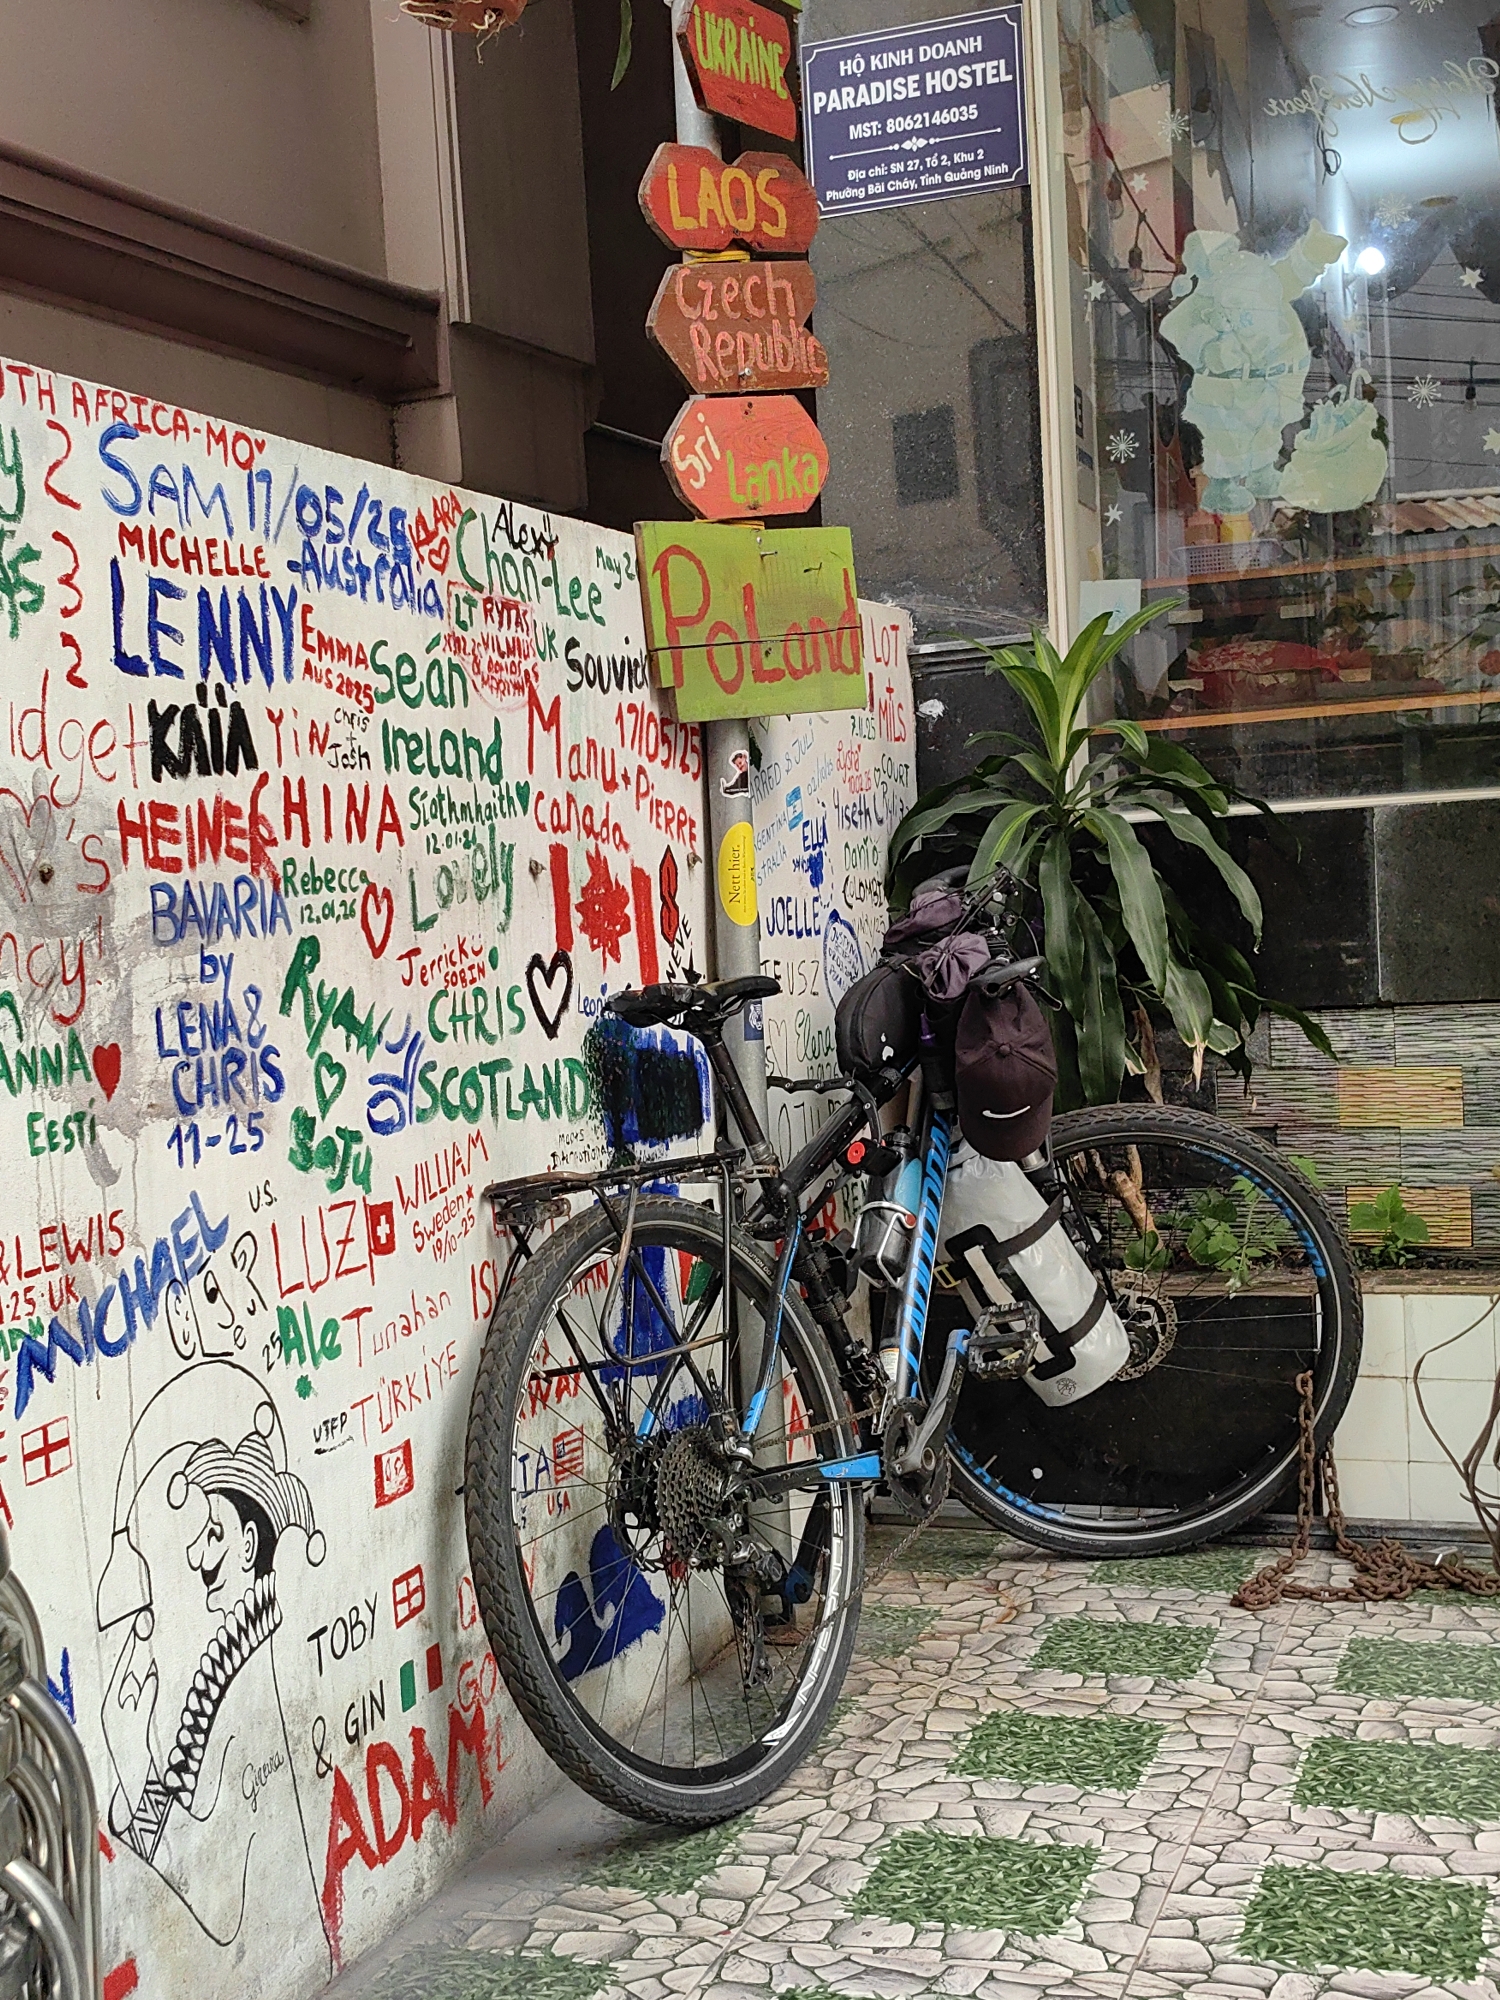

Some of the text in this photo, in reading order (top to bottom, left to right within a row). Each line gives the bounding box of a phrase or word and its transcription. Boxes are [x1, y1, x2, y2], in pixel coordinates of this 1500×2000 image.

[813, 59, 1013, 115] PARADISE HOSTEL
[839, 35, 983, 78] HỘ KINH DOANH
[849, 104, 979, 140] MST: 8062146035
[826, 185, 865, 201] Phường
[887, 173, 918, 192] Cháy,
[984, 163, 1009, 177] Ninh
[848, 167, 866, 183] Địa
[890, 160, 905, 173] SN
[907, 158, 924, 172] 27,
[941, 154, 951, 167] 2,
[954, 151, 972, 164] Khu
[977, 148, 985, 160] 2
[667, 162, 787, 238] LAOS
[675, 262, 796, 320] Czech
[44, 419, 81, 510] 2
[673, 412, 721, 489] Sri
[726, 447, 820, 504] Lanka
[51, 530, 83, 618] 3
[118, 521, 271, 578] MICHELLE
[624, 551, 638, 581] 2
[110, 555, 298, 692] LENNY
[301, 603, 370, 670] EMMA
[533, 619, 559, 662] UK
[60, 631, 88, 689] 2
[382, 716, 504, 785] Ireland
[250, 771, 405, 853] CHINA
[283, 856, 371, 898] Rebecca
[728, 844, 741, 904] Nett hier.
[150, 874, 293, 947] BAVARIA
[766, 895, 821, 939] JOELLE
[200, 943, 234, 1003] by
[155, 1000, 242, 1058] LENA
[428, 985, 526, 1046] CHRIS
[172, 1045, 286, 1117] CHRIS
[415, 1057, 591, 1132] SCOTLAND
[395, 1128, 489, 1215] WILLIAM
[15, 1209, 124, 1281] LEWIS
[413, 1192, 465, 1253] Sweden
[15, 1190, 229, 1421] MICHAEL
[341, 1289, 451, 1367] Tunahan
[307, 1591, 378, 1677] TOBY
[344, 1679, 386, 1746] GIN
[321, 1702, 494, 1973] ADAM
